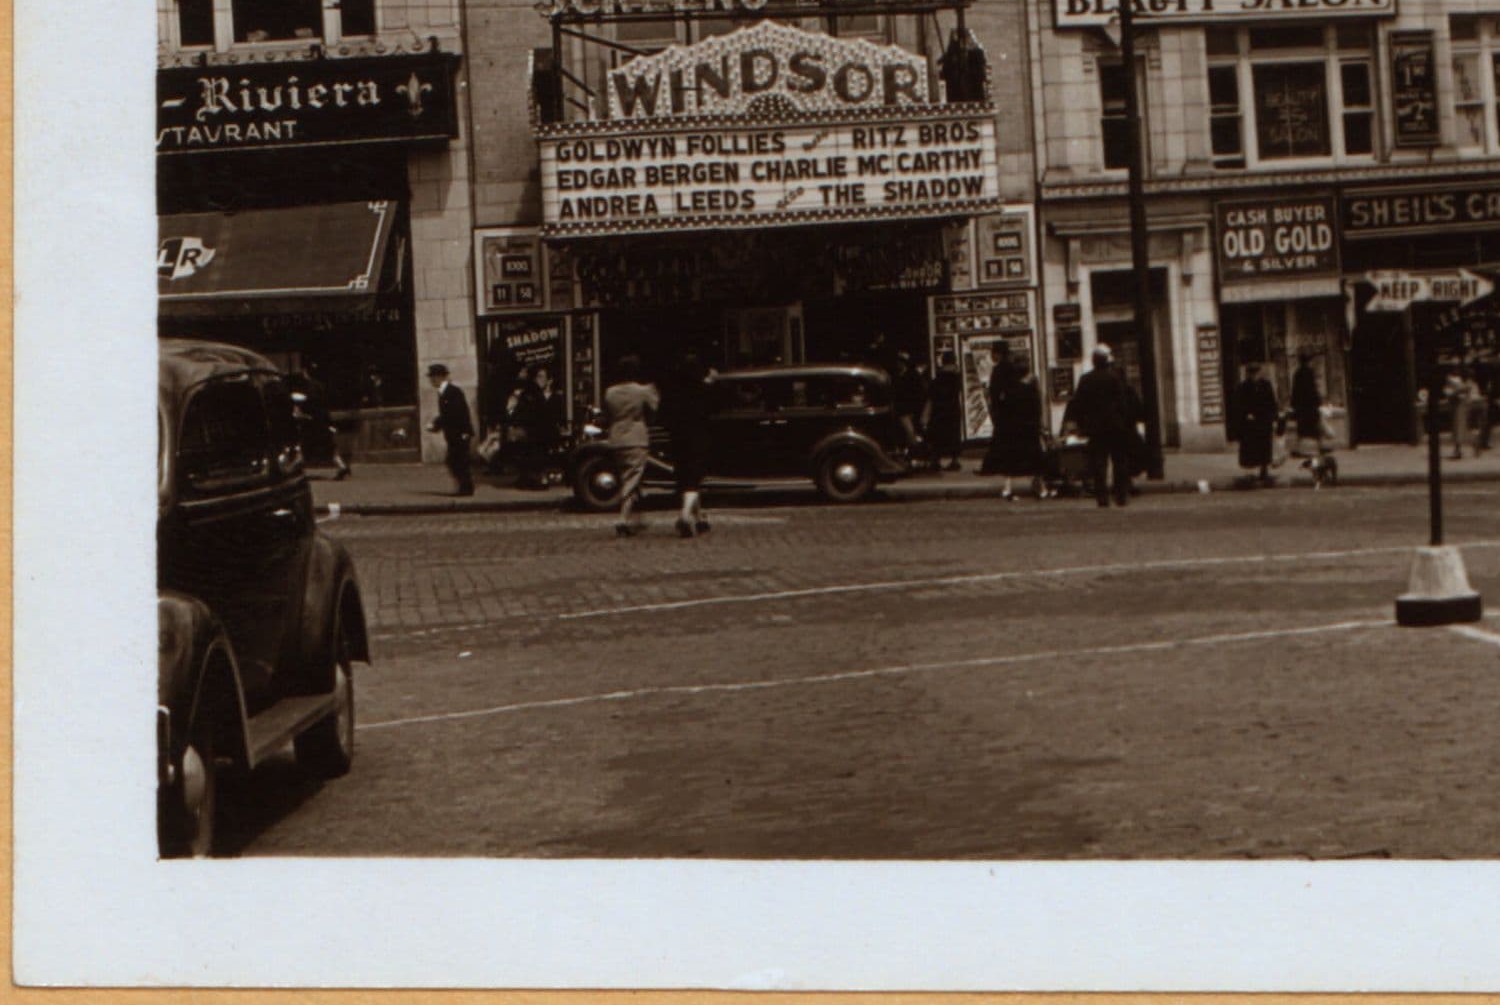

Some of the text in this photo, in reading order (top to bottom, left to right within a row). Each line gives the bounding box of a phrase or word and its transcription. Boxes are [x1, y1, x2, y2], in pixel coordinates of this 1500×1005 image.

[613, 49, 928, 117] WINDSOR
[556, 138, 676, 162] GOLDWYN
[687, 132, 786, 156] FOLLIES
[852, 126, 907, 149] RITZ
[919, 121, 979, 145] BROS
[557, 148, 983, 191] EDGAR BERGEN CHARLIE MC CARTHY
[559, 193, 658, 220] ANDREA
[676, 189, 755, 214] LEEDS
[818, 182, 865, 207] THE
[884, 176, 984, 202] SHADOW
[1227, 205, 1326, 226] CASH BUYER
[1224, 224, 1332, 258] OLD GOLD
[1242, 255, 1318, 272] & SILVER
[1380, 278, 1478, 300] KEEP RIGHT
